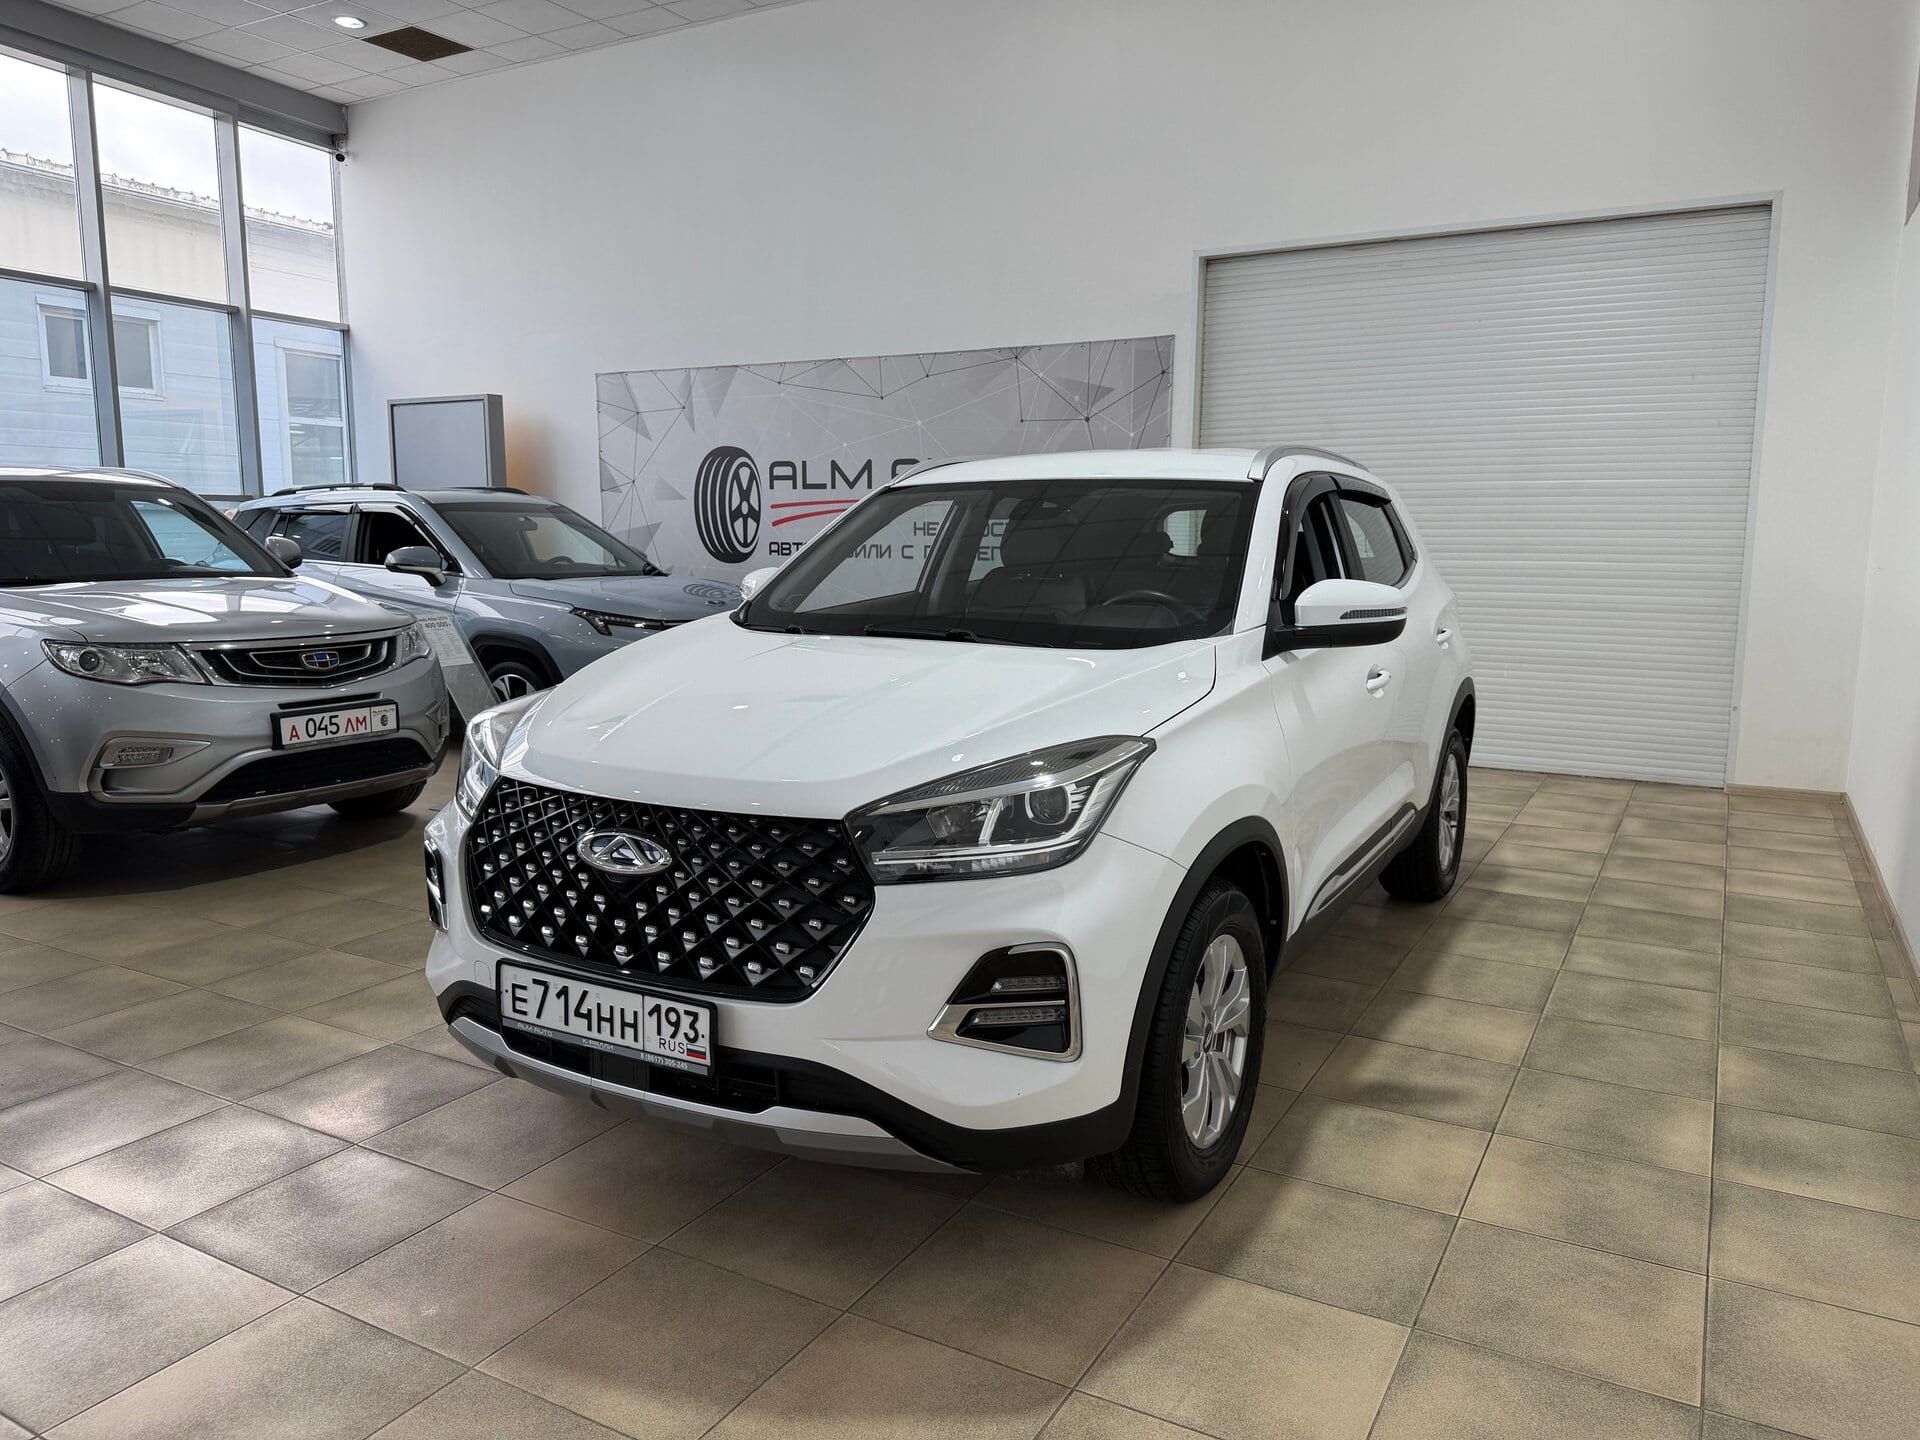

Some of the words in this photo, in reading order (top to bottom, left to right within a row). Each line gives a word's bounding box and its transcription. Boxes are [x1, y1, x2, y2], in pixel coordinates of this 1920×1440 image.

[769, 458, 873, 490] ALM
[901, 545, 914, 559] С
[305, 714, 340, 738] 045
[511, 977, 639, 1043] Е714НН
[648, 1003, 700, 1044] 193
[658, 1038, 685, 1054] RUS
